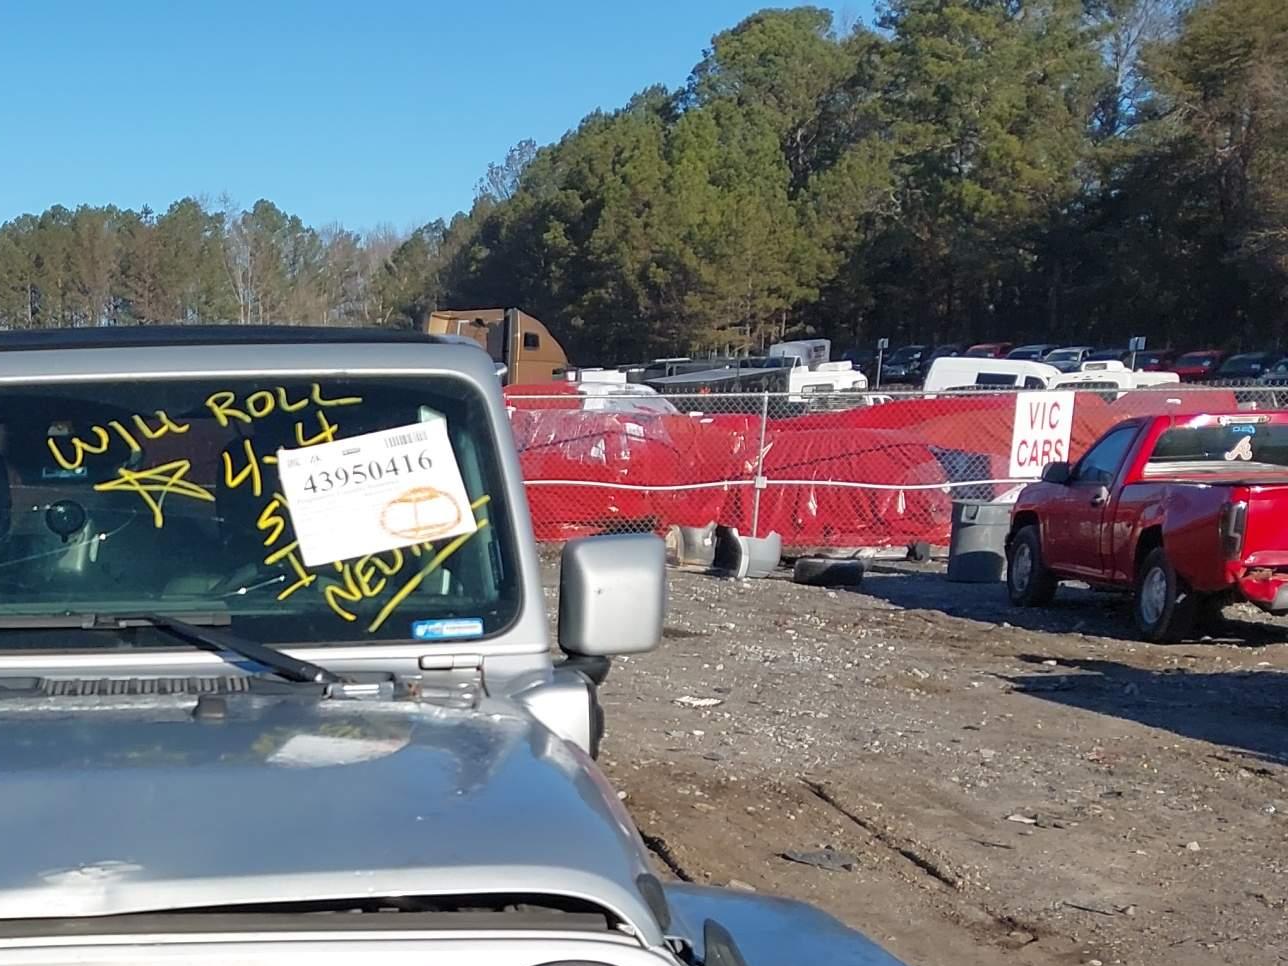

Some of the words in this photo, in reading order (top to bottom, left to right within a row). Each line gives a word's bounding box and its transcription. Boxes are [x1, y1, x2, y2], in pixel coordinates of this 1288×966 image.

[47, 410, 190, 470] WILL
[205, 383, 362, 427] ROLL
[1029, 401, 1061, 430] VIC
[303, 448, 433, 493] 43950416
[1016, 438, 1063, 467] CARS
